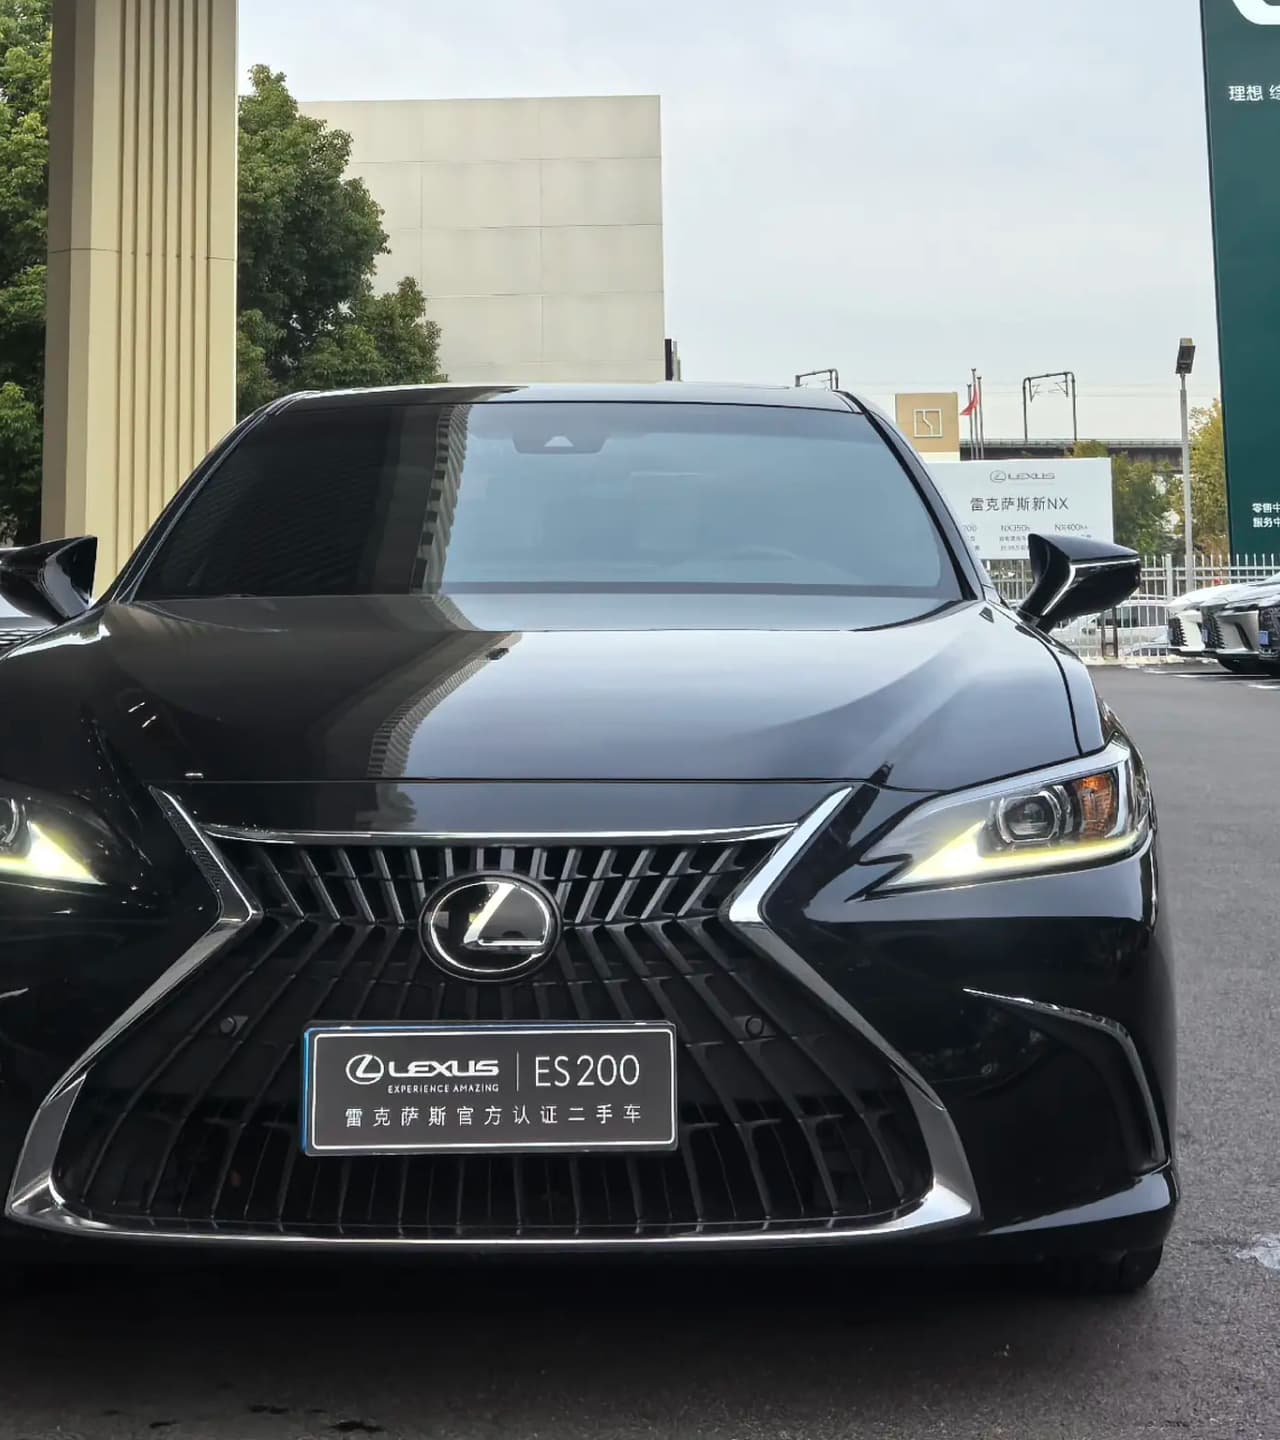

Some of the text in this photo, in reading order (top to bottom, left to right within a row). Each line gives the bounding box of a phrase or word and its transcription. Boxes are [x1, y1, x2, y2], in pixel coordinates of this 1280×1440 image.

[1229, 85, 1263, 101] 理想
[1008, 472, 1055, 480] LEXUS
[971, 497, 1069, 512] 雷克萨斯新NX
[388, 1060, 500, 1078] LEXUS
[387, 1083, 500, 1094] EXPERIENCE AMAZING
[345, 1103, 642, 1128] 雷克萨斯官方认证二手车
